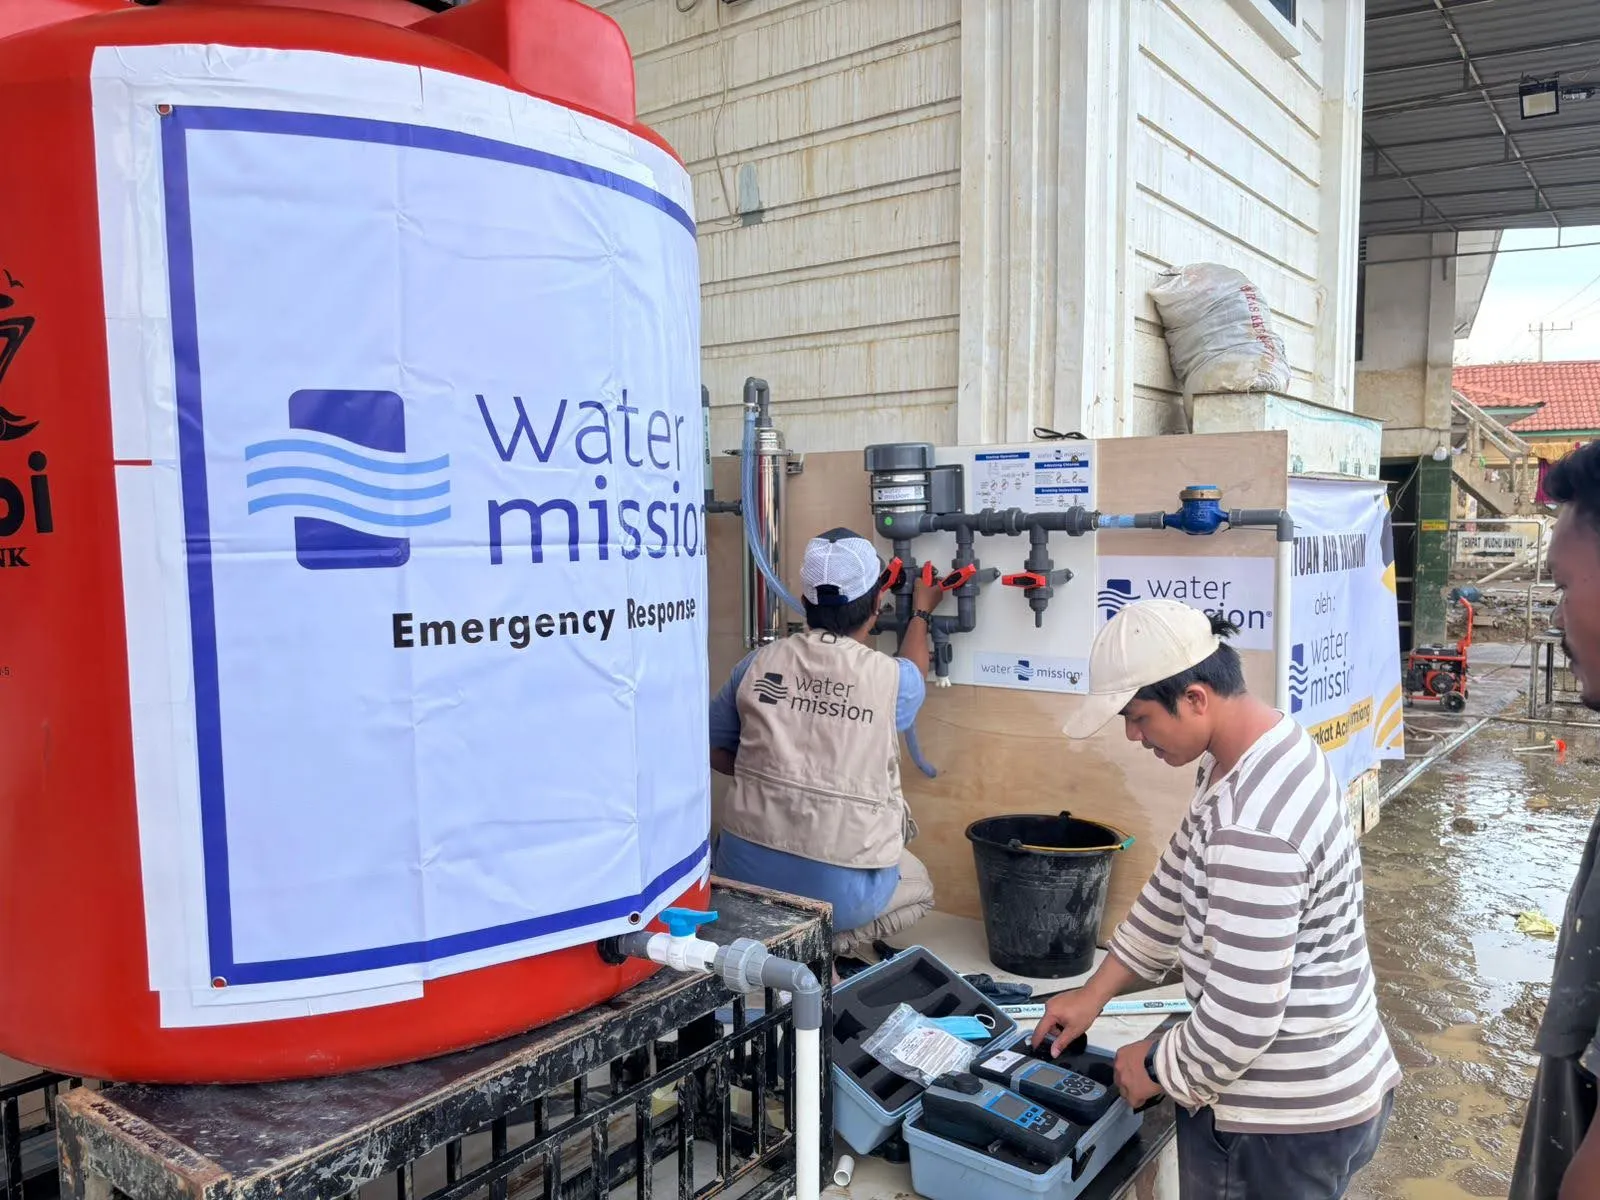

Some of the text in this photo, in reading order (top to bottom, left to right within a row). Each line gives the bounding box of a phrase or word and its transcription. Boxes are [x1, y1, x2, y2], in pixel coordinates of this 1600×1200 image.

[475, 389, 684, 471] water
[488, 475, 706, 565] mission
[1291, 536, 1319, 576] TUAN
[1323, 535, 1338, 573] AIR
[1147, 576, 1231, 600] water
[392, 598, 696, 649] Emergency Response
[1311, 628, 1349, 666] water
[796, 676, 855, 699] water
[981, 663, 1081, 680] water mission
[1310, 661, 1351, 707] missi
[791, 695, 874, 723] mission
